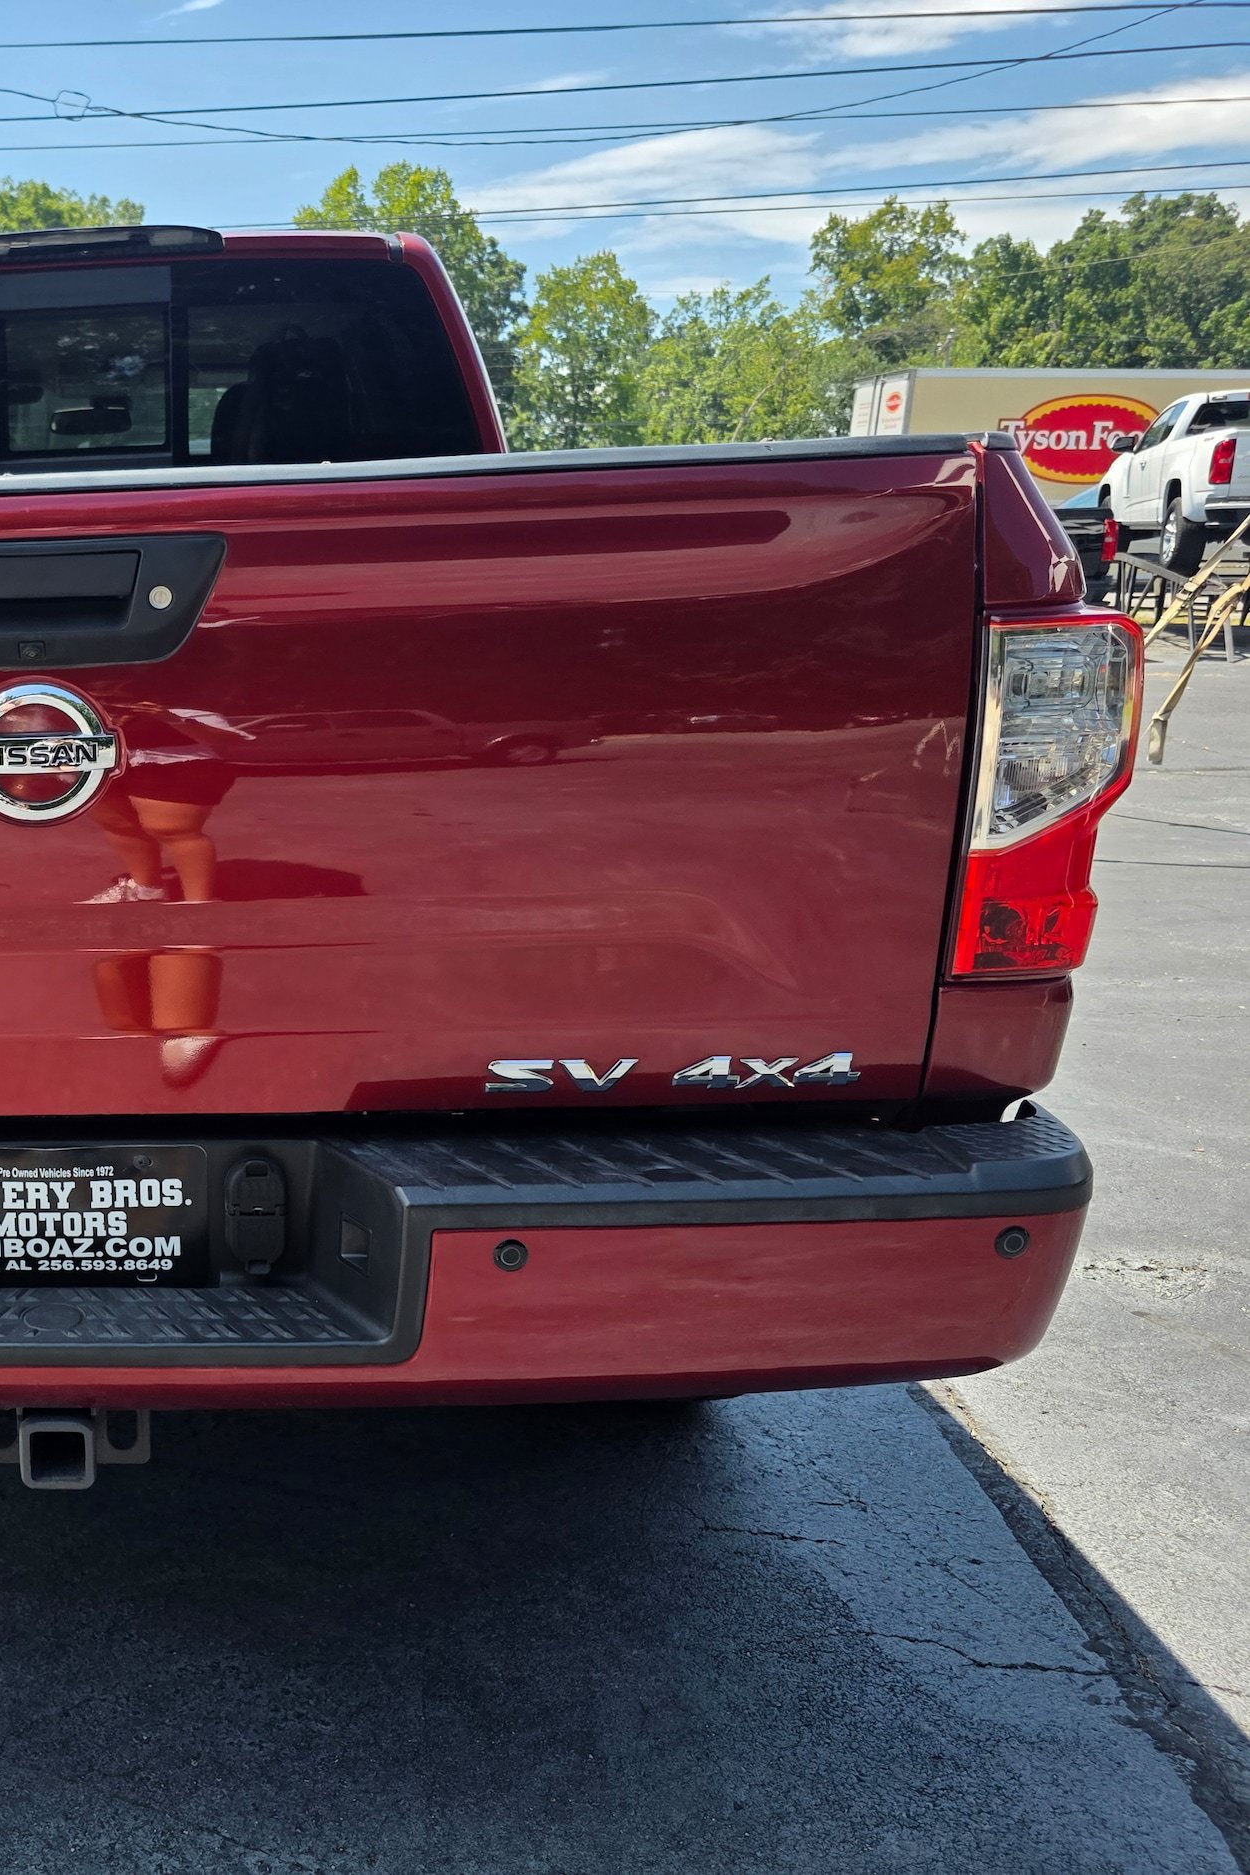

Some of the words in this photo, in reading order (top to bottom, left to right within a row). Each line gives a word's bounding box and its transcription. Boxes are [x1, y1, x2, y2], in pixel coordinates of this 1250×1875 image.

[999, 420, 1088, 454] Tyson
[1091, 420, 1145, 452] Foo
[485, 1058, 639, 1092] SV
[12, 1167, 38, 1178] Owned
[39, 1167, 71, 1178] Vehicles
[72, 1166, 94, 1178] Since
[95, 1166, 114, 1177] 1972
[90, 1178, 192, 1209] BROS.
[5, 1260, 32, 1271] AL
[37, 1259, 174, 1271] 256.593.8649
